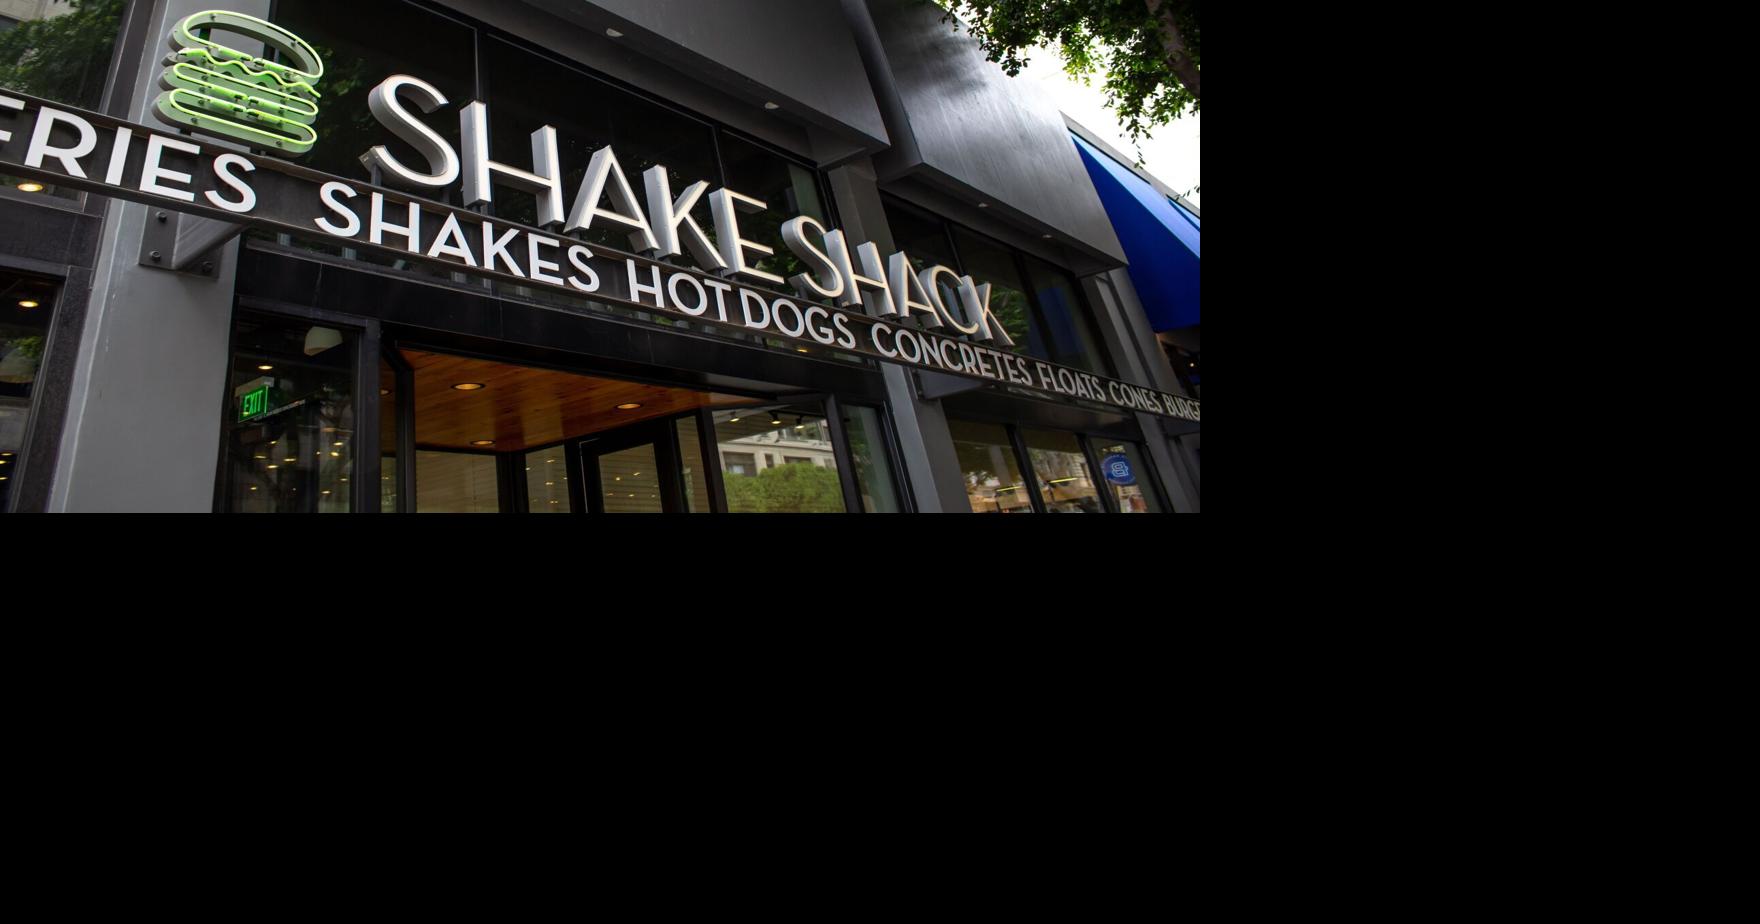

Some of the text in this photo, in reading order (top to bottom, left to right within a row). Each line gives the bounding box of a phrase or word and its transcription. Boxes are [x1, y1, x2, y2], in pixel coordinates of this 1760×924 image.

[314, 181, 600, 292] SHAKES
[871, 322, 1033, 386] CONCRETES
[1035, 362, 1106, 401] FLOATS
[1108, 380, 1163, 414] CONES
[359, 74, 1015, 347] SHAKE SHACK
[243, 390, 263, 415] EXIT
